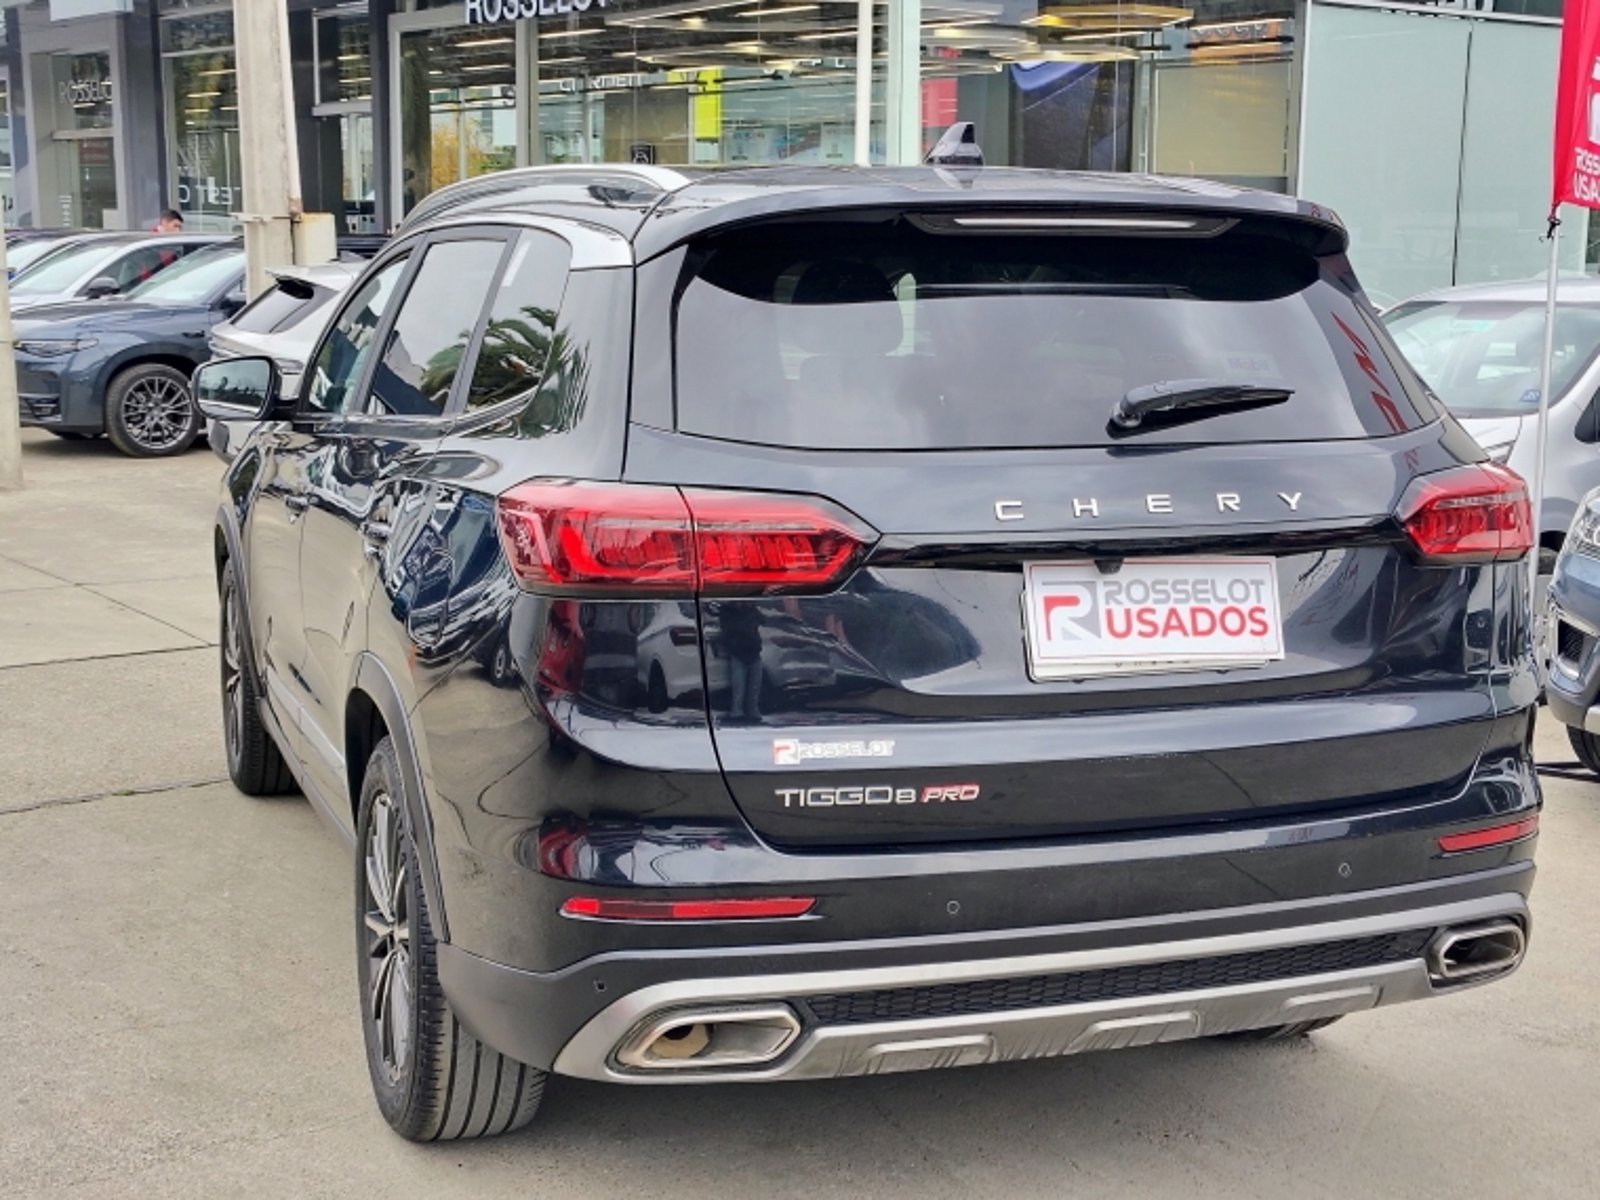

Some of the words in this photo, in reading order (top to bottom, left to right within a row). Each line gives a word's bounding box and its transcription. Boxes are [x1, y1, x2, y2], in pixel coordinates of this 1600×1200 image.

[994, 492, 1302, 520] CHERY
[1103, 577, 1266, 605] ROSSELOT
[1105, 605, 1269, 639] USADOS
[921, 784, 980, 803] PRO
